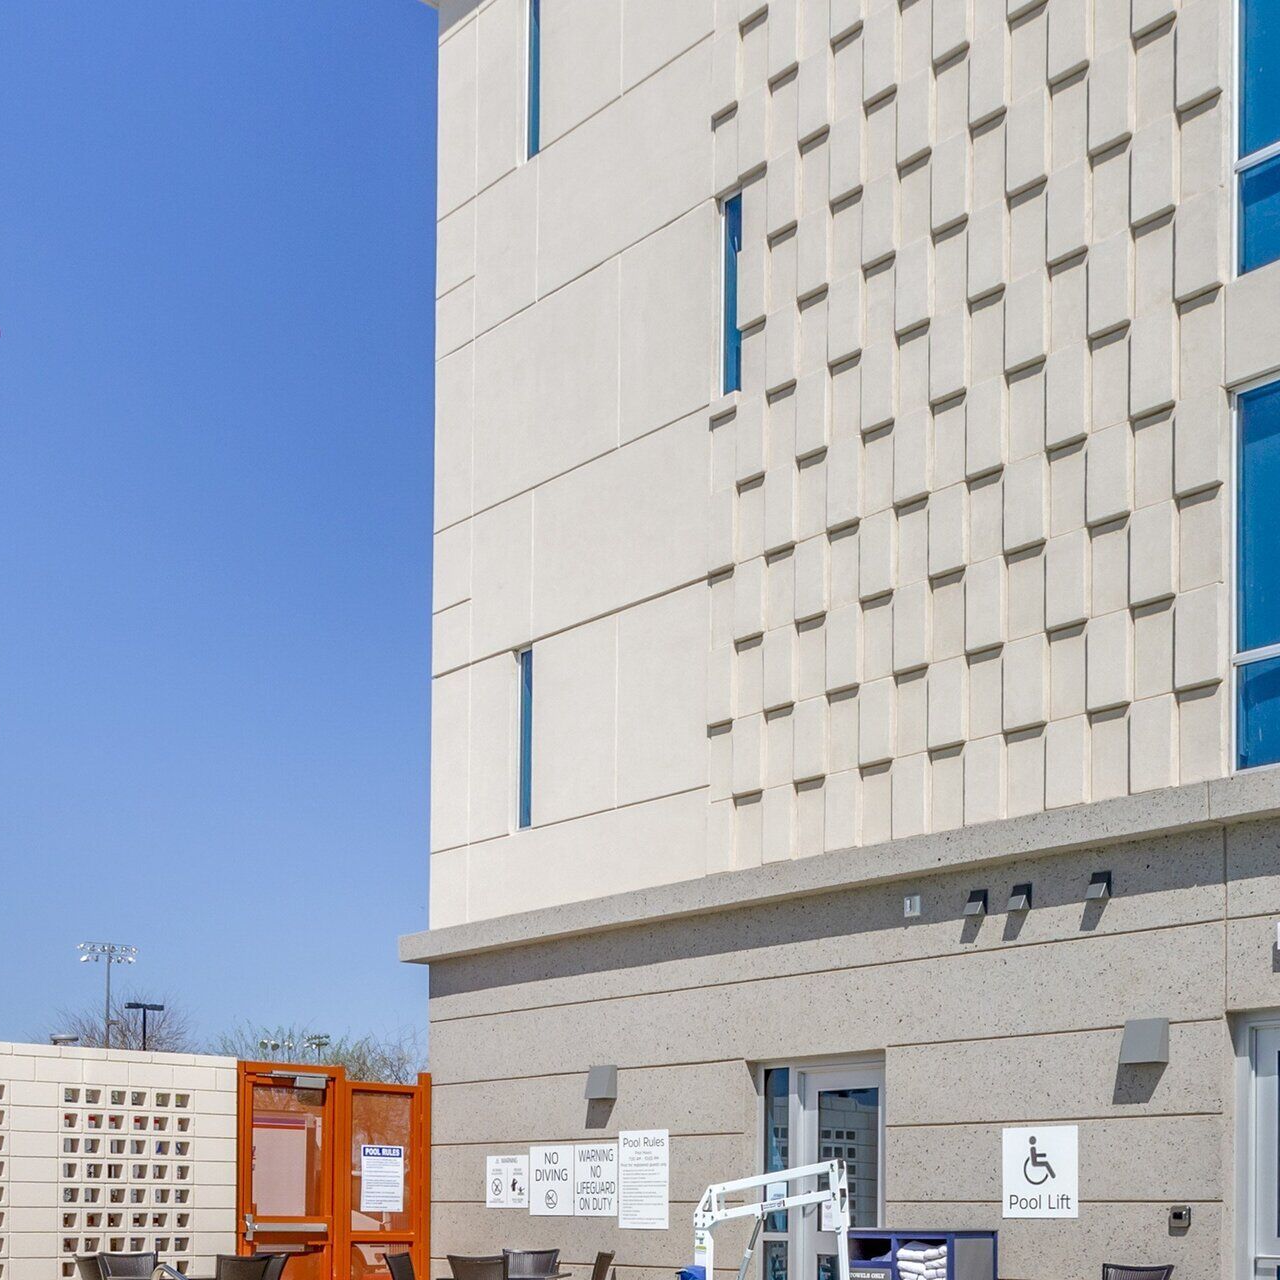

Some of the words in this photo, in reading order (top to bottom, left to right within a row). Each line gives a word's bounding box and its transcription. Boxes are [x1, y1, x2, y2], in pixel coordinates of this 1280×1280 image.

[623, 1137, 641, 1148] Pool
[643, 1136, 665, 1147] Rules
[544, 1152, 559, 1165] NO
[578, 1148, 614, 1162] WARNING
[535, 1168, 568, 1181] DIVING
[590, 1165, 601, 1178] NO
[576, 1181, 615, 1194] LIFEGUARD
[579, 1197, 590, 1210] ON
[592, 1197, 613, 1210] DUTY
[1009, 1194, 1042, 1210] Pool
[1048, 1193, 1071, 1209] Lift
